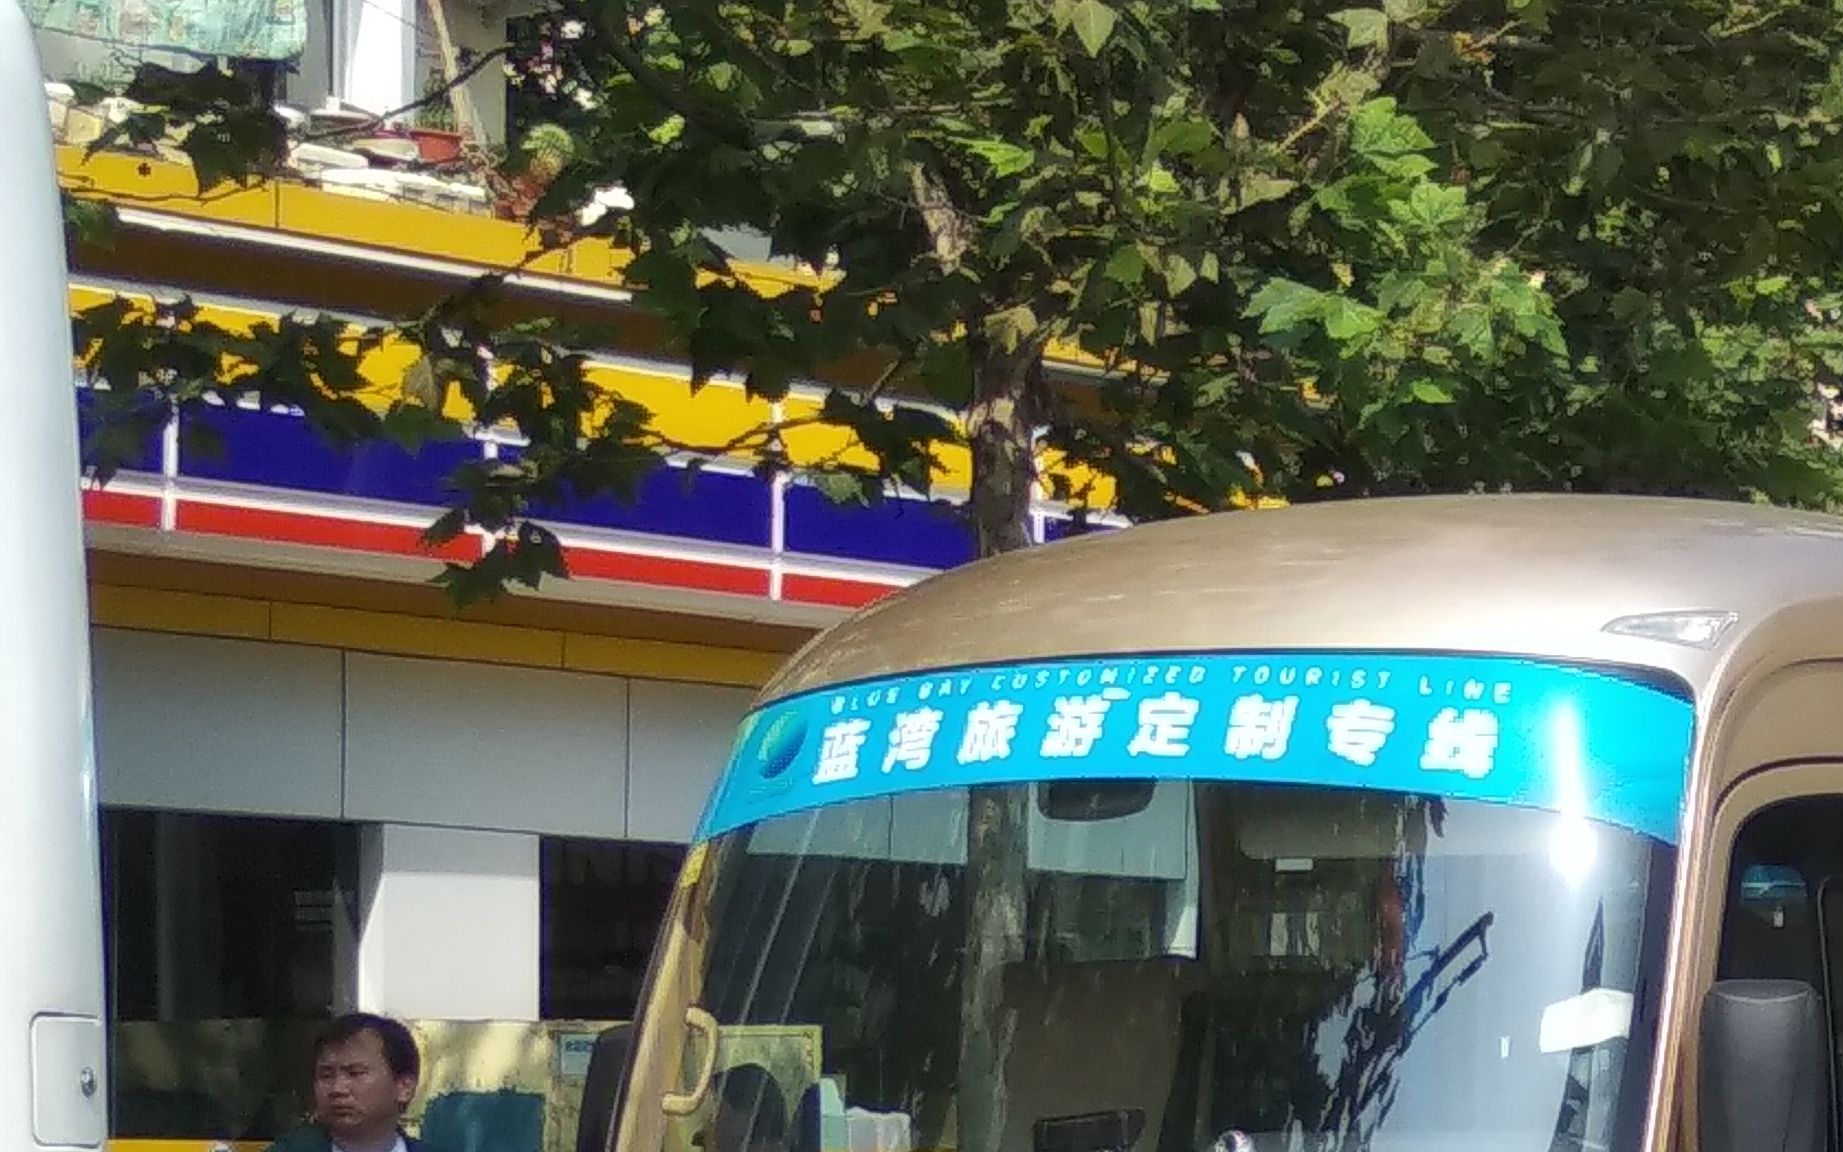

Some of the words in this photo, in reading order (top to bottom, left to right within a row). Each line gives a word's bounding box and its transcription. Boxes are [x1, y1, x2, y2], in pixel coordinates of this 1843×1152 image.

[830, 687, 899, 715] BLUE
[918, 679, 972, 700] BAY
[991, 662, 1206, 691] CUSTOMIZED
[1232, 665, 1391, 689] TOURIST
[1419, 676, 1514, 704] LINE
[811, 691, 1499, 784] 蓝湾旅游定制专线
